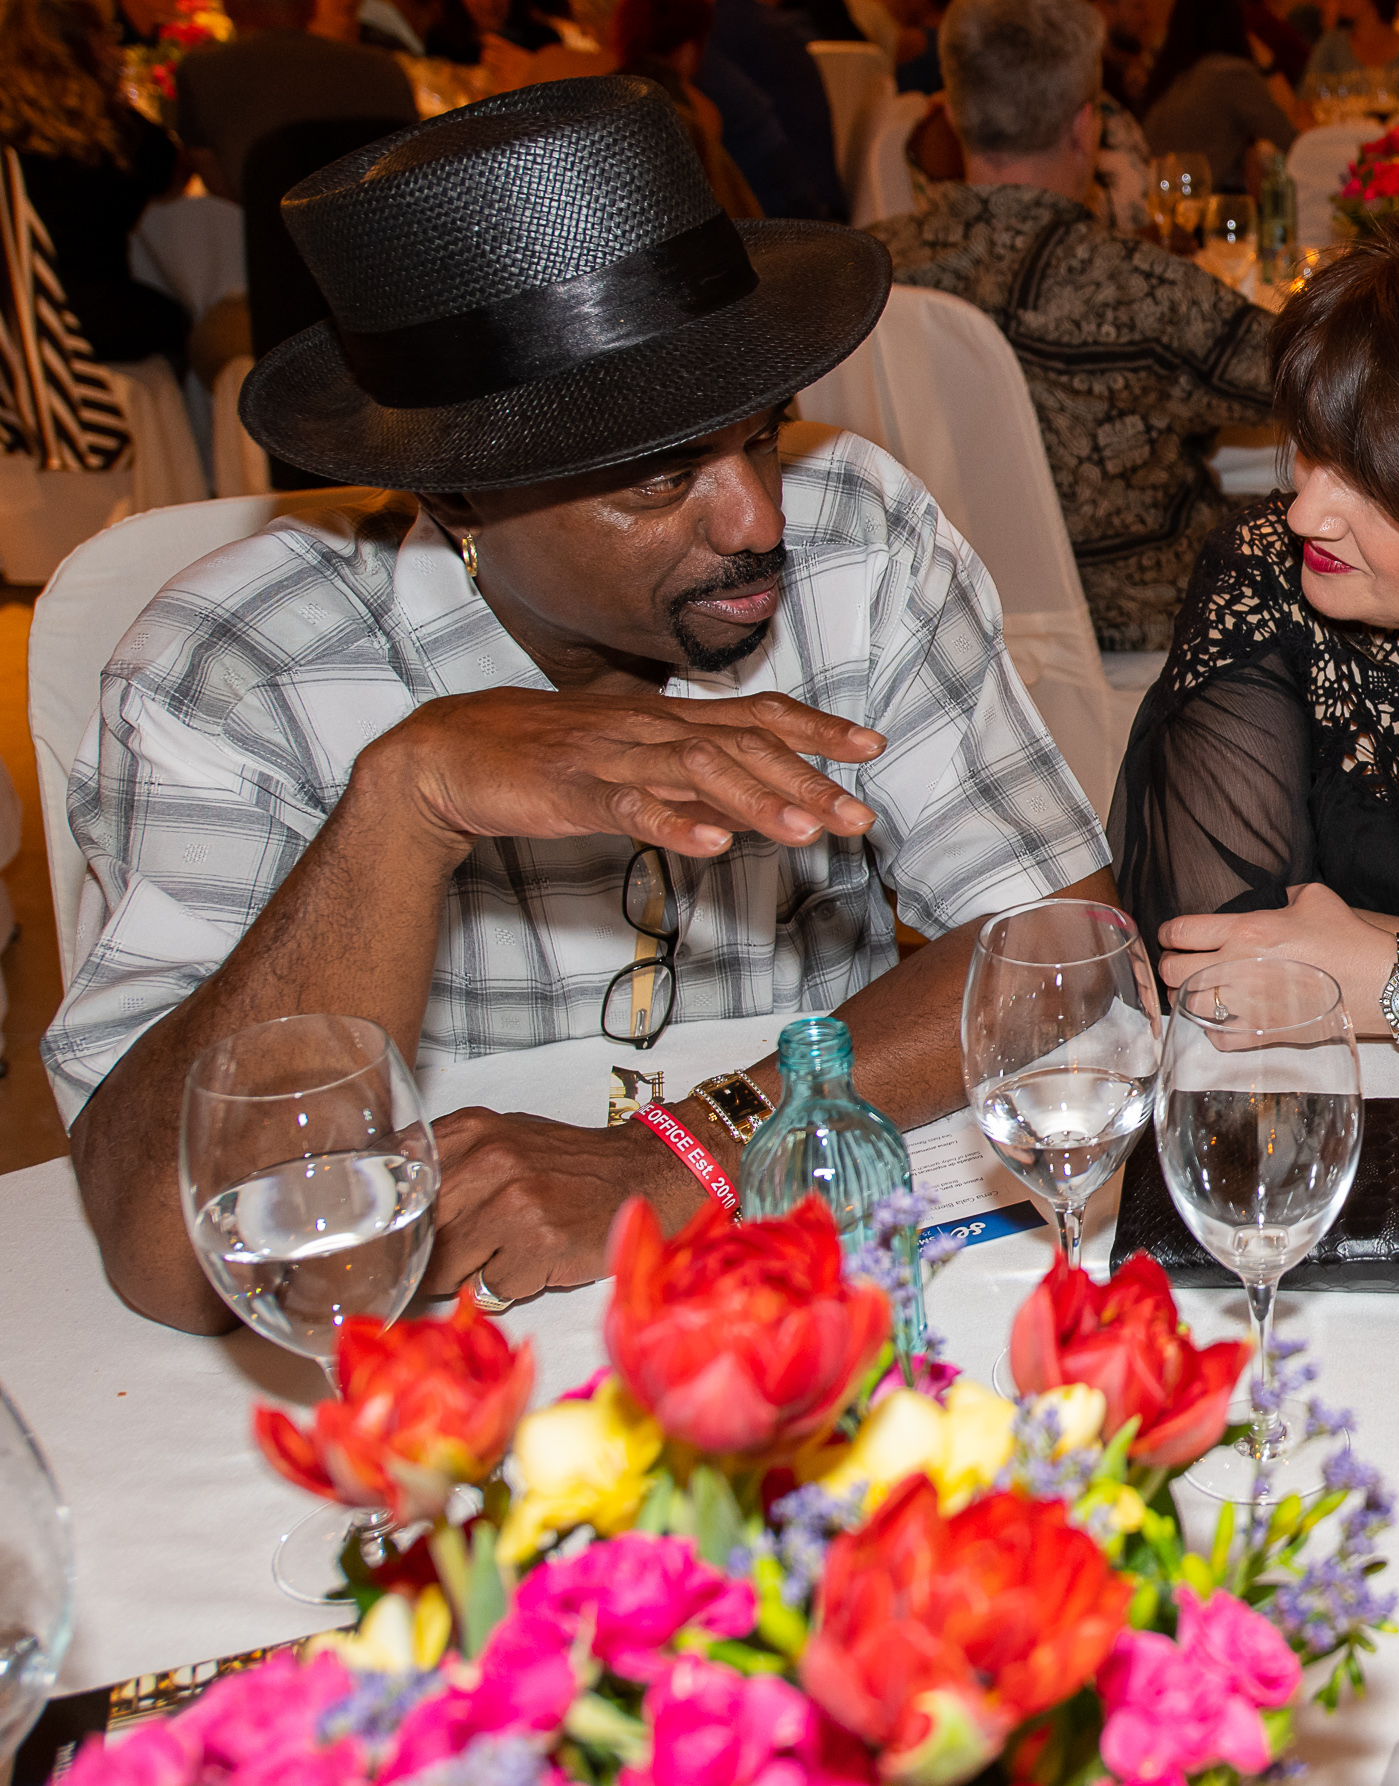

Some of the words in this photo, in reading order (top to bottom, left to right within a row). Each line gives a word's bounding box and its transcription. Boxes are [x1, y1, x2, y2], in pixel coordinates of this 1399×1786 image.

[647, 1110, 694, 1152] OFFICE
[687, 1148, 714, 1180] Est.
[710, 1177, 736, 1210] 2010
[959, 1154, 984, 1164] Ensalada
[917, 1161, 941, 1171] spinach
[918, 1164, 947, 1175] espinacas
[963, 1177, 984, 1185] Palitos
[976, 1190, 999, 1200] Cena
[930, 1203, 955, 1211] Bienv
